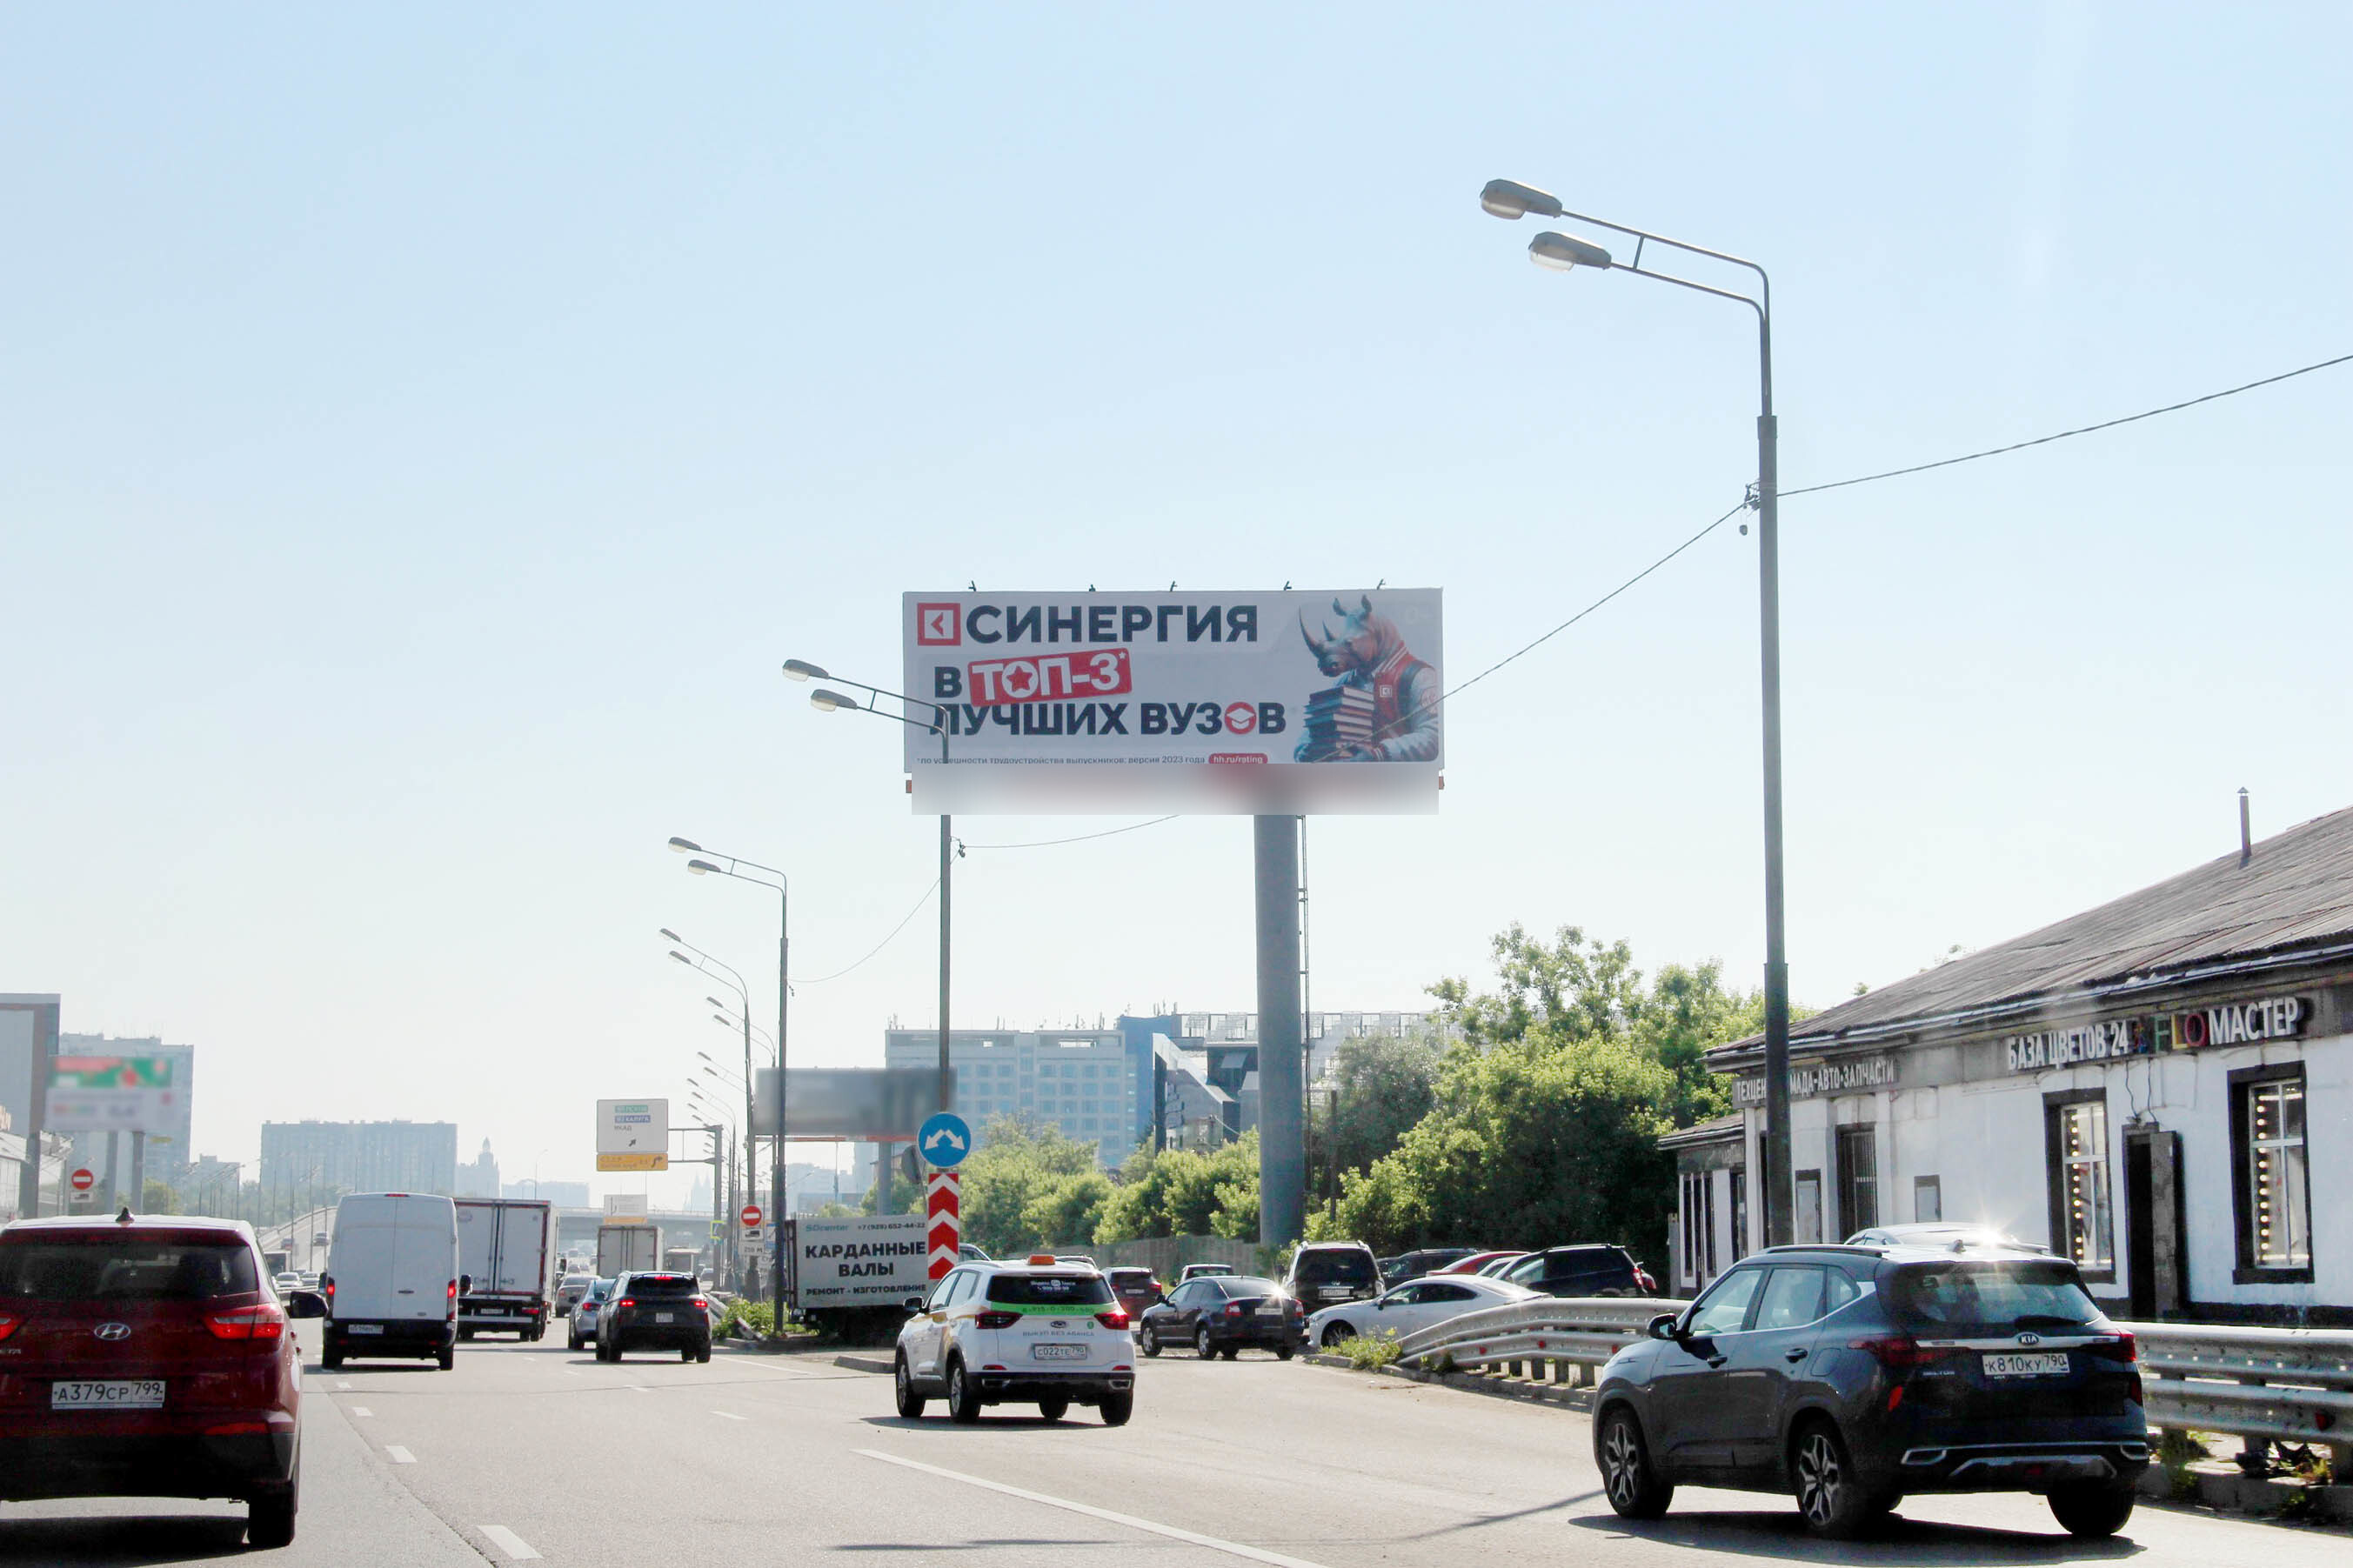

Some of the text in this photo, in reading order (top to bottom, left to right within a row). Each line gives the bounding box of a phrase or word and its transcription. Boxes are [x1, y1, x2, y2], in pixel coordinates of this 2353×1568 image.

[966, 604, 1258, 644] СИНЕРГИЯ
[933, 665, 963, 698] В
[929, 701, 1287, 736] ЛУЧШИХ ВУЗОВ
[1161, 756, 1184, 764] 2023
[2007, 1033, 2043, 1071] БАЗА
[2047, 1023, 2107, 1071] ЦВЕТОВ
[2110, 1019, 2129, 1058] 24
[1736, 1078, 1768, 1104] ТЕХЦЕН
[805, 1241, 926, 1260] КАРДАННЫЕ
[839, 1263, 894, 1278] ВАЛЫ
[806, 1287, 845, 1296] РЕМОНТ
[853, 1284, 926, 1295] ИЗГОТОВЛЕНИЕ
[2020, 1333, 2037, 1344] KIA
[1987, 1356, 2042, 1372] К810КУ
[57, 1382, 161, 1401] А379СР 799
